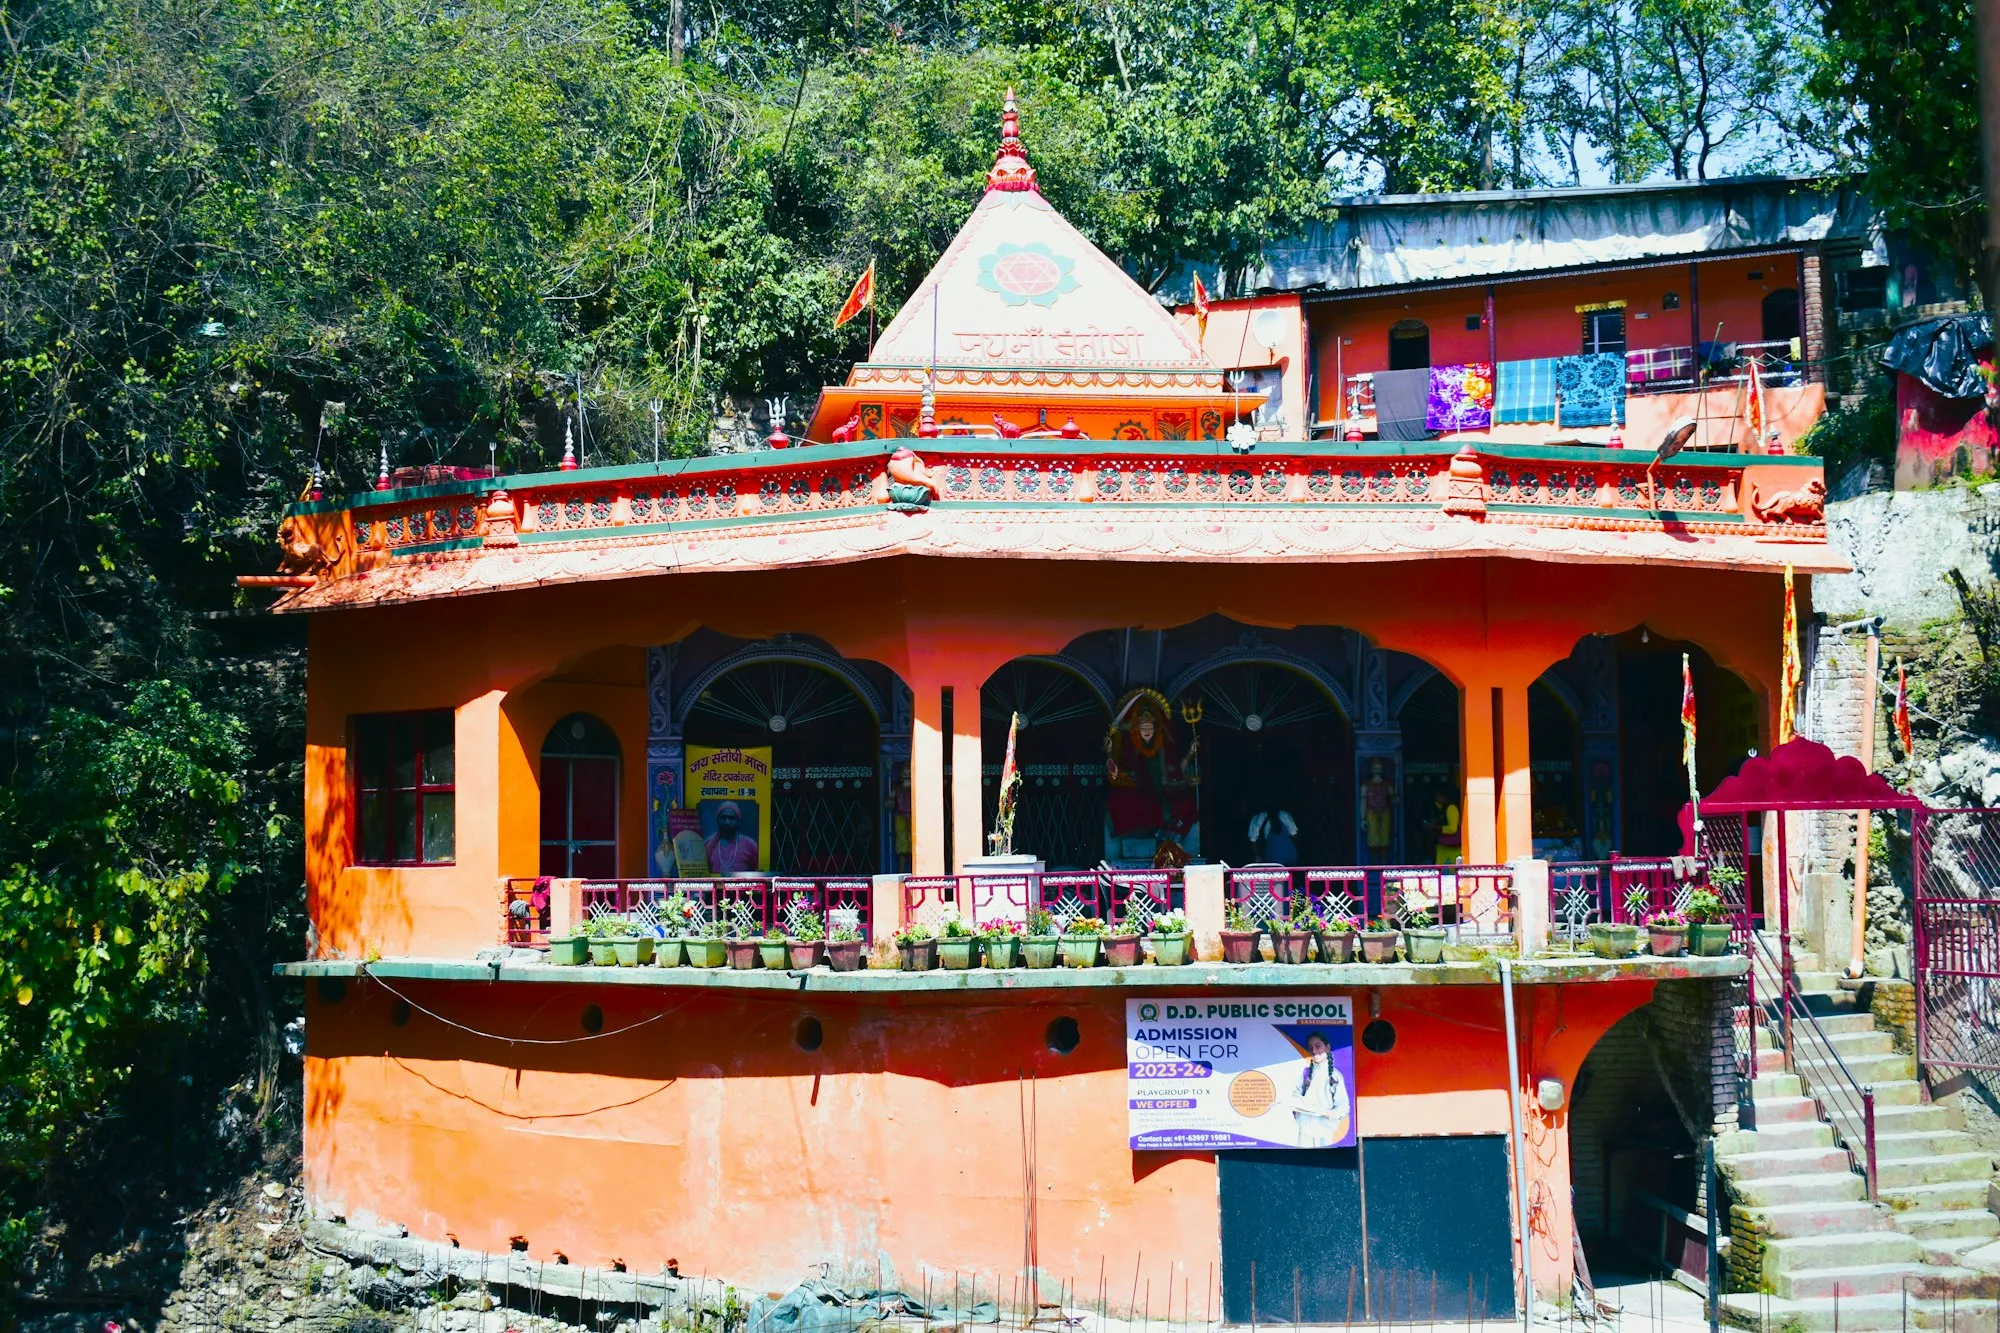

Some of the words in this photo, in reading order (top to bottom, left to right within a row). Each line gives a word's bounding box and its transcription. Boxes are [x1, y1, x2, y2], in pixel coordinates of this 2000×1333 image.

[1048, 324, 1144, 360] संतोषी
[690, 756, 709, 773] जय
[712, 748, 742, 764] संतोषी
[745, 754, 767, 776] माता
[703, 770, 721, 781] मंदिर
[724, 771, 755, 782] टपकेश्वर
[701, 788, 728, 796] स्थापना
[1167, 1005, 1203, 1019] D.D.
[1207, 1004, 1269, 1018] PUBLIC
[1273, 1004, 1347, 1018] SCHOOL
[1134, 1027, 1237, 1041] ADMISSION
[1136, 1044, 1191, 1060] OPEN
[1199, 1044, 1239, 1059] FOR
[1134, 1062, 1206, 1077] 2023-24
[1136, 1101, 1154, 1109] WE
[1156, 1100, 1190, 1108] OFFER
[1174, 1134, 1208, 1142] +91-63997
